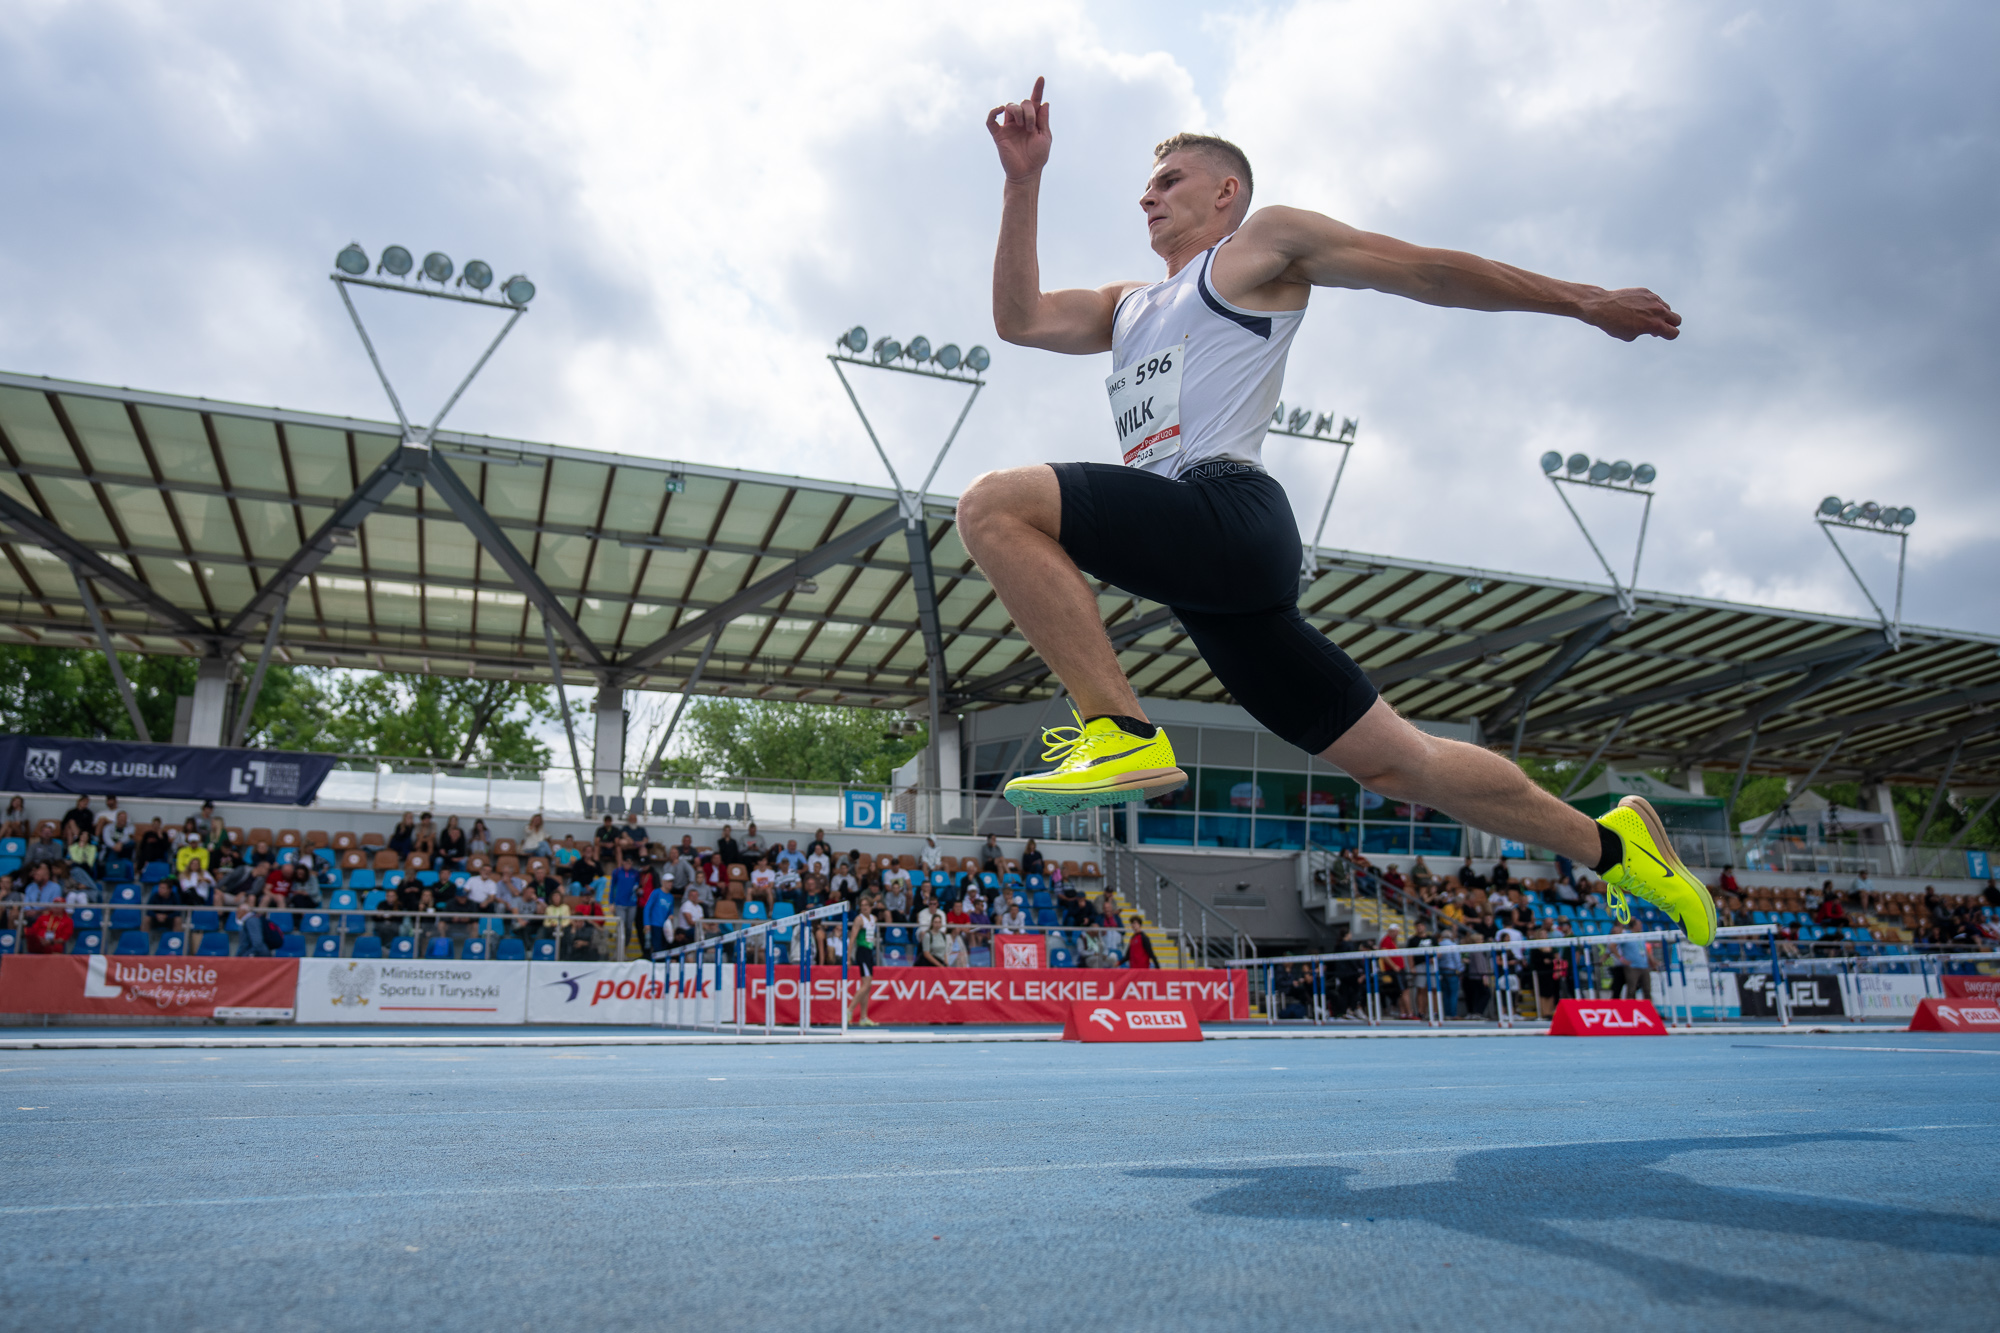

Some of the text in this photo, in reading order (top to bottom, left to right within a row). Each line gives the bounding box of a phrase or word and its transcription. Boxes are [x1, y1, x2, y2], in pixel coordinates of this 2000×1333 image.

[1107, 352, 1172, 396] UMCS 596
[1115, 396, 1155, 441] WILK
[1160, 429, 1173, 439] U20
[1191, 462, 1250, 479] NIKE
[69, 759, 107, 775] AZS
[111, 762, 177, 778] LUBLIN
[853, 801, 875, 826] D
[115, 962, 218, 985] lubelskie
[380, 966, 473, 981] Ministerstwo
[379, 982, 501, 999] Sportu i Turystyki
[590, 973, 712, 1006] polanik
[871, 979, 1003, 1004] ZWIĄZEK
[1009, 981, 1114, 1000] LEKKIEJ
[1131, 1014, 1182, 1026] ORLEN
[1578, 1008, 1654, 1028] PZLA
